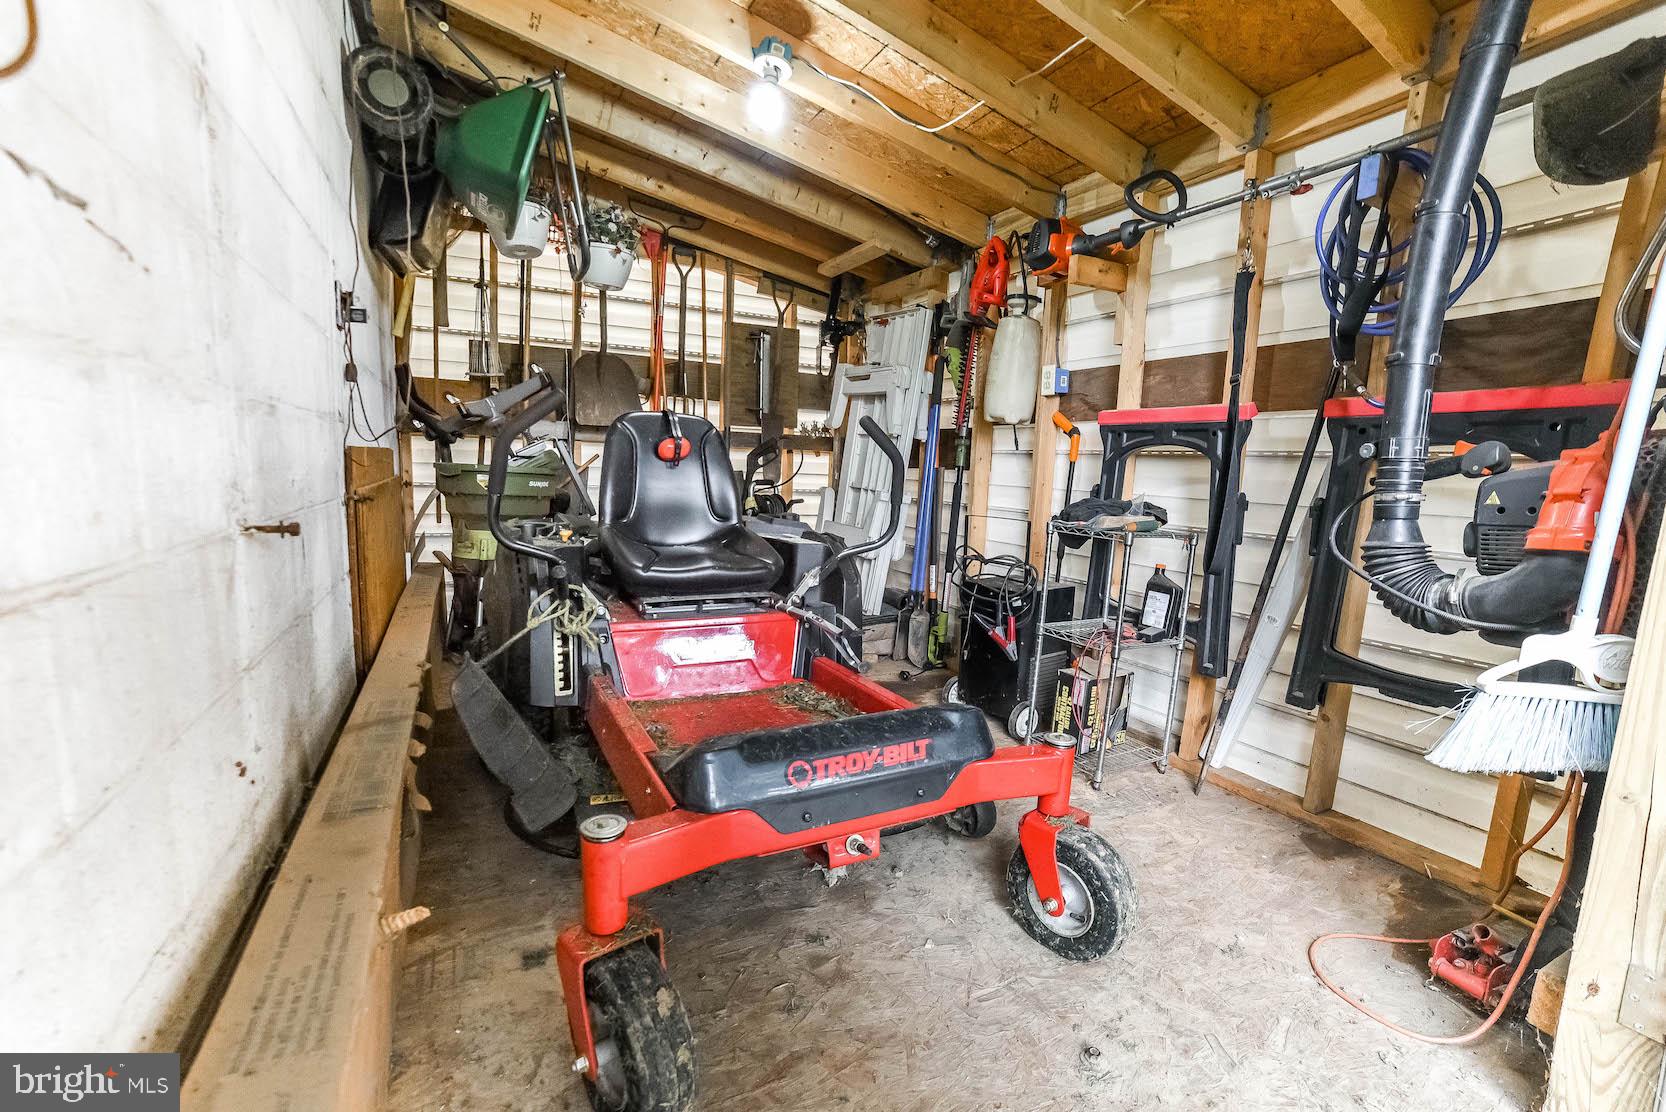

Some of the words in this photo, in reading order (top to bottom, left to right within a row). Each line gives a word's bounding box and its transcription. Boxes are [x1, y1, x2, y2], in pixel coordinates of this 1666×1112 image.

[1057, 685, 1070, 735] CONTRACTOR
[1064, 705, 1072, 730] GALLON
[1088, 686, 1097, 715] GALLON
[812, 738, 930, 781] TROY-BILT
